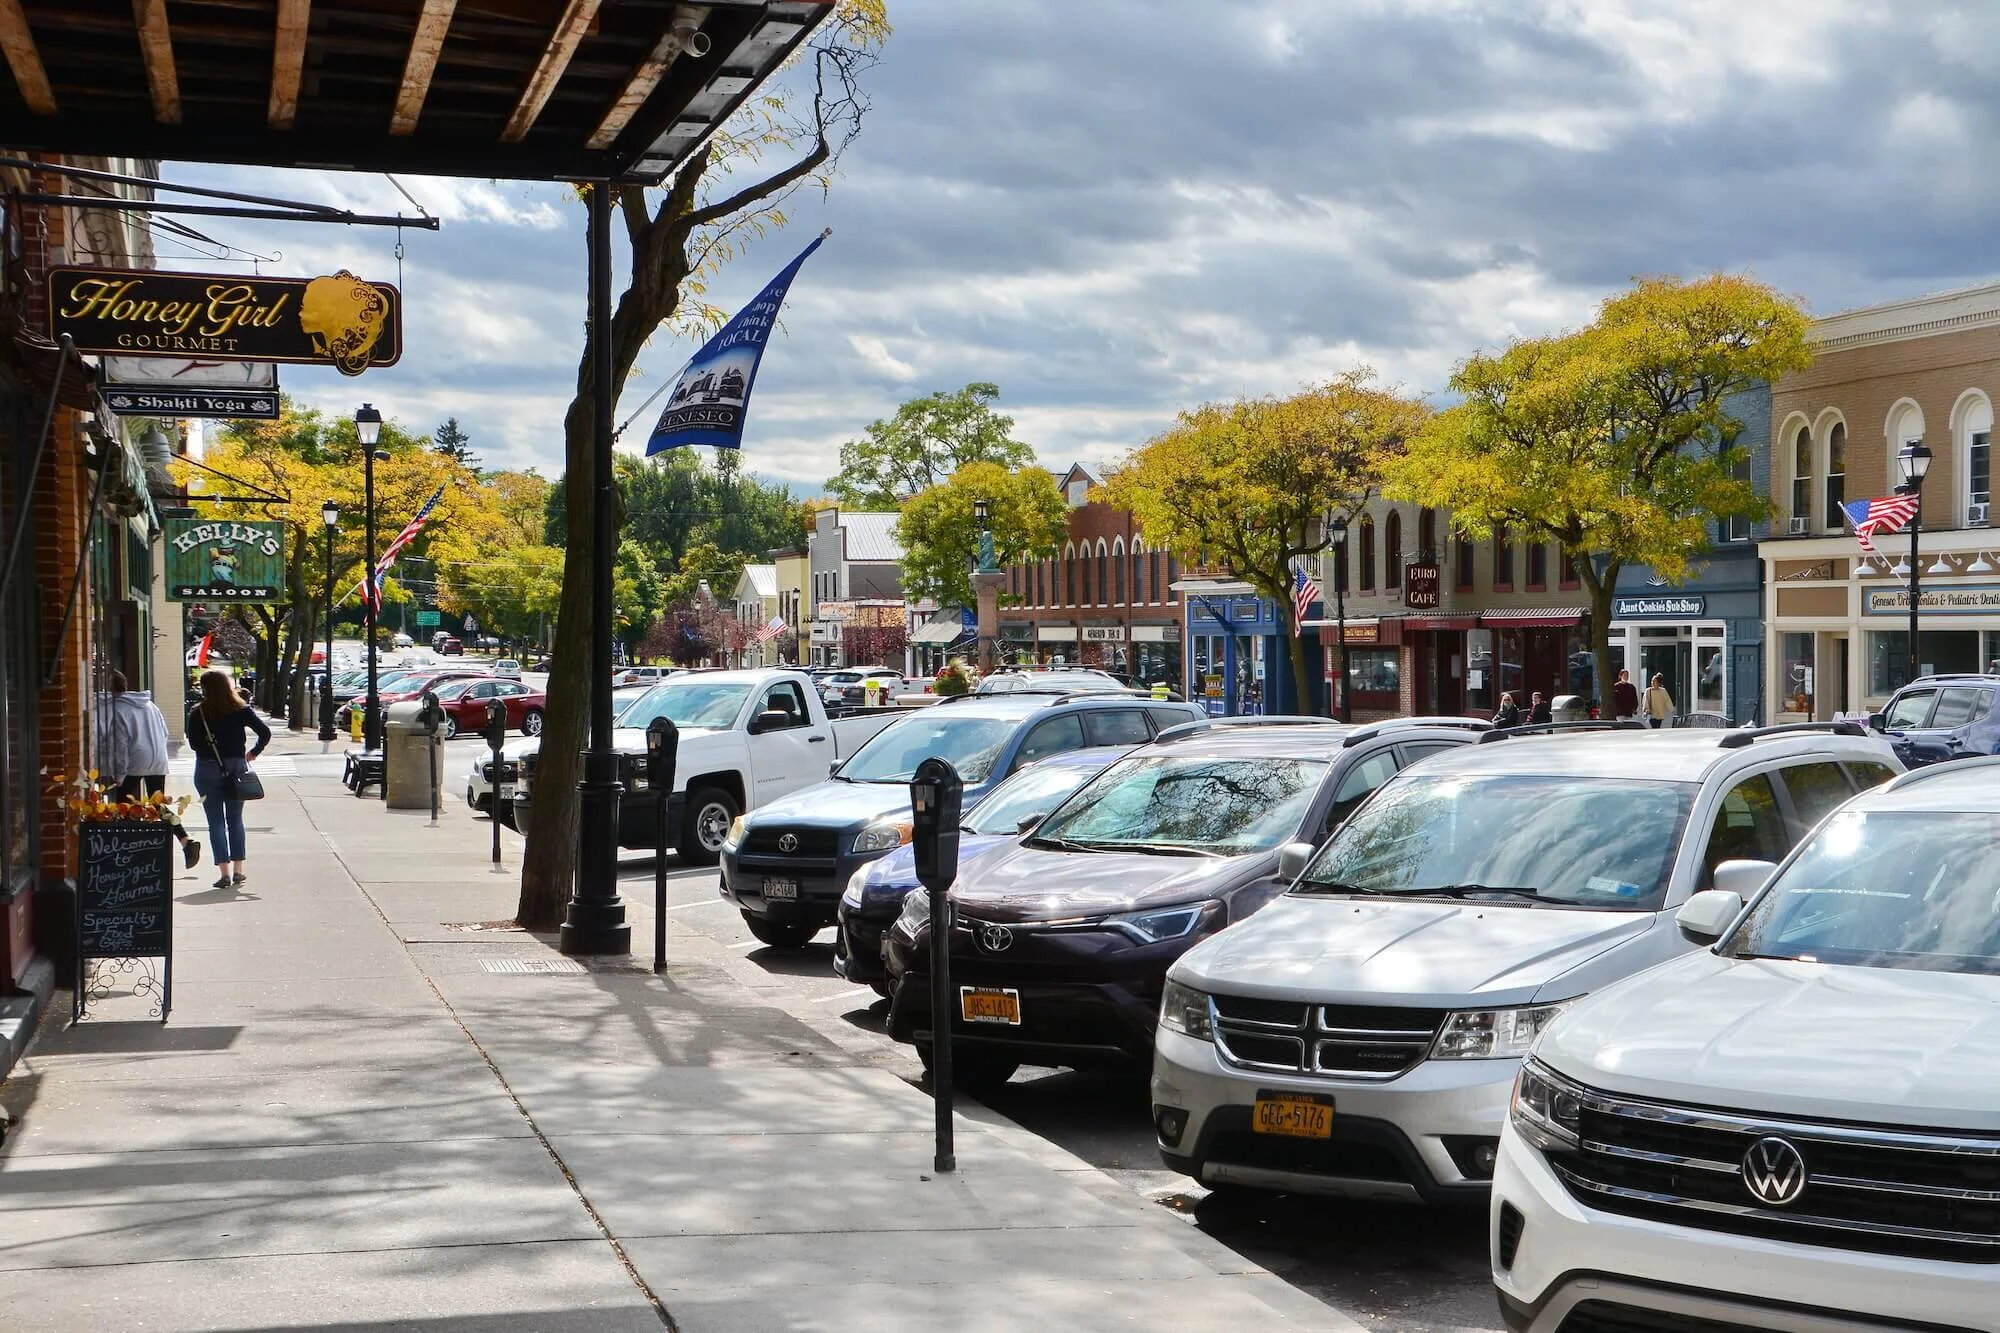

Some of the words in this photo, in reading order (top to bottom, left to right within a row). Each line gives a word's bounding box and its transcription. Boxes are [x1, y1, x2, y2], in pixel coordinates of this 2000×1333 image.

[60, 278, 204, 335] Honey
[199, 284, 290, 337] Girl
[117, 333, 239, 352] GOURMET
[137, 395, 198, 411] Shakti
[203, 398, 246, 413] Yoga
[172, 523, 280, 556] KELLY'S
[1410, 567, 1437, 580] EURO
[182, 588, 268, 596] SALOON
[1872, 594, 1896, 609] Geneseo
[1947, 593, 1979, 606] Pediatric
[1619, 600, 1638, 613] Aunt
[1665, 599, 1681, 612] Sub
[1680, 599, 1700, 613] Shop
[87, 834, 165, 857] Welcome
[113, 852, 132, 867] to
[98, 879, 164, 906] Gourmet
[84, 912, 156, 931] Specialty
